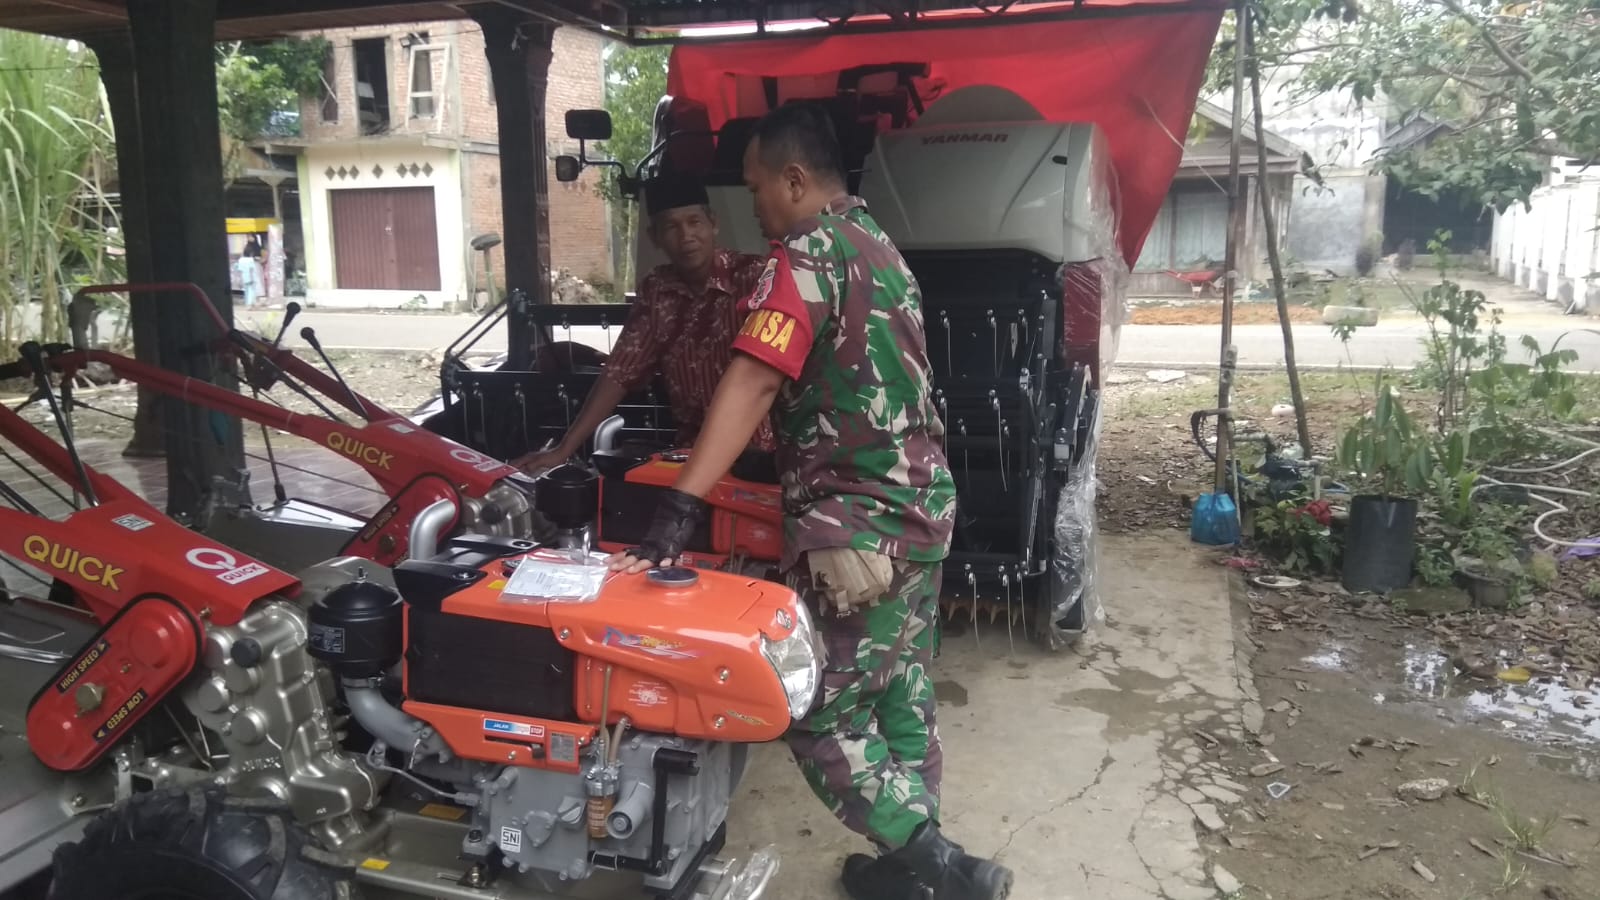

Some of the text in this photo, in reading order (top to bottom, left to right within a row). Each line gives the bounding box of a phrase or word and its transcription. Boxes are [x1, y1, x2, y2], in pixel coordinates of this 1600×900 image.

[920, 133, 1009, 145] YANMAR
[327, 431, 395, 471] QUICK
[23, 535, 124, 591] QUICK
[222, 564, 263, 582] QUICK
[60, 649, 99, 689] HIGH SPEED
[106, 691, 144, 729] LOW SPEED
[502, 831, 520, 844] SNI
